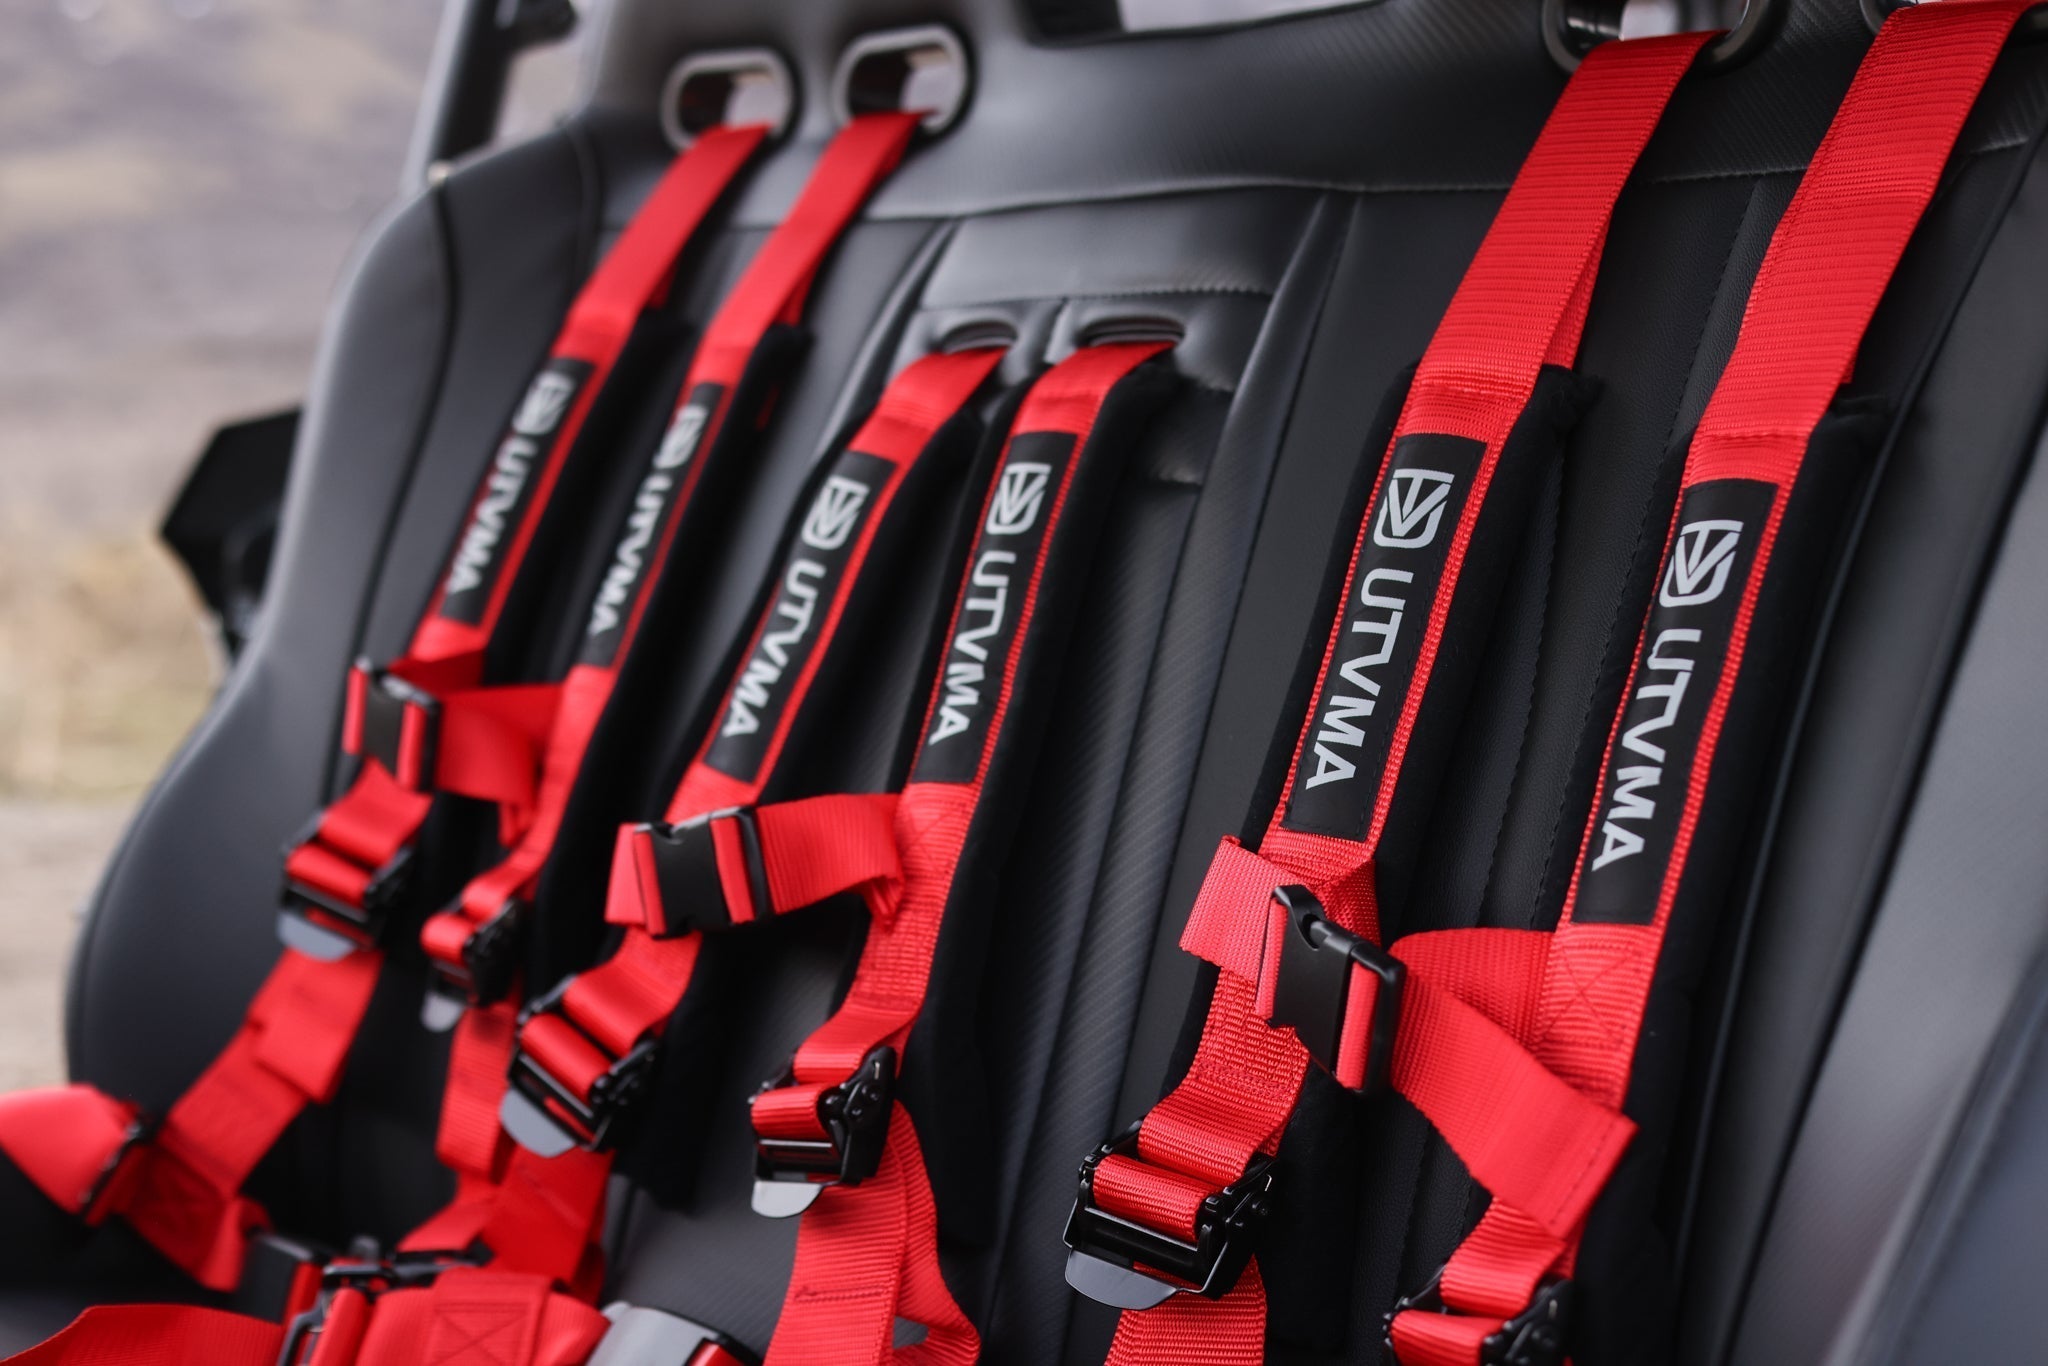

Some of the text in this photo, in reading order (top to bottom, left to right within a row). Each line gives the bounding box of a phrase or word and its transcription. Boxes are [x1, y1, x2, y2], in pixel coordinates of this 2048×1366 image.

[446, 436, 538, 595] UTVMA
[588, 473, 673, 636] UTVMA
[722, 559, 827, 738] UTVMA
[928, 550, 1017, 746] UTVMA
[1305, 567, 1414, 790] UTVMA
[1591, 627, 1702, 872] UTVMA
